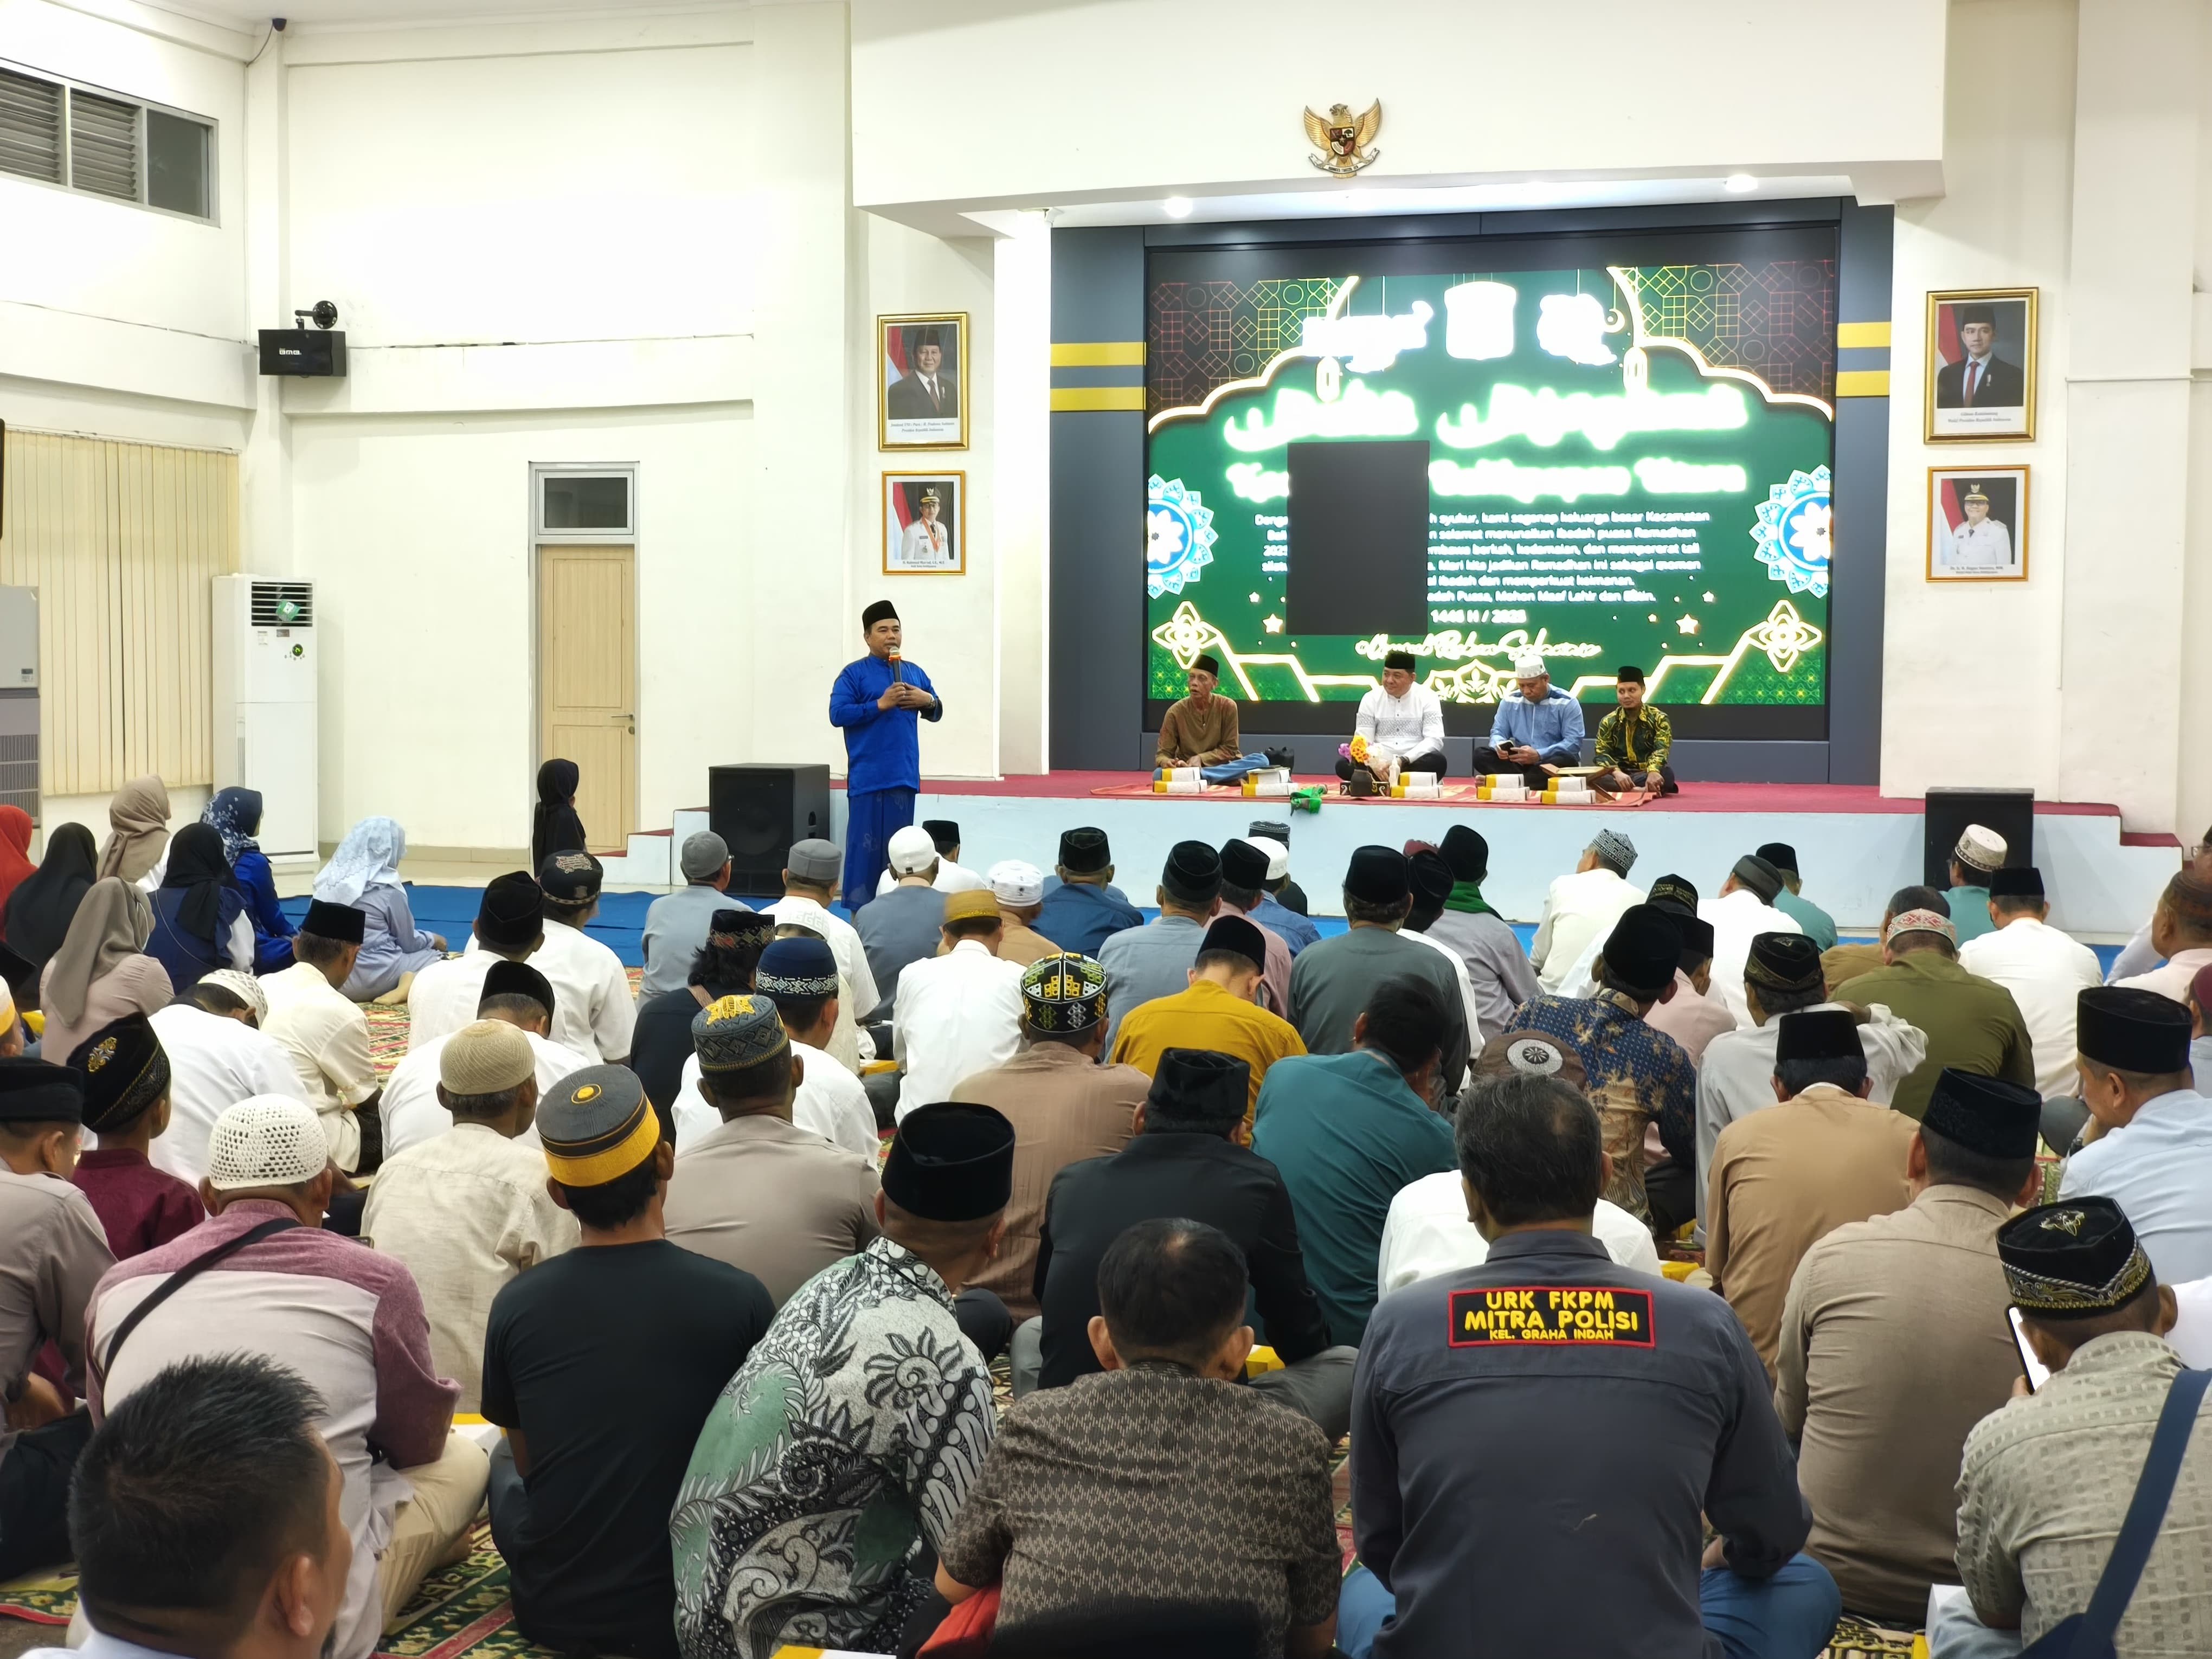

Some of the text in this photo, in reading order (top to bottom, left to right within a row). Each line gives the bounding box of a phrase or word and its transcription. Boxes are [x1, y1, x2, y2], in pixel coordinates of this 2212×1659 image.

[1646, 511, 1709, 522] Kecamatan
[1583, 543, 1605, 554] dan
[1478, 575, 1500, 586] dan
[1568, 590, 1597, 601] Lahir
[1599, 590, 1621, 601] dan
[1467, 609, 1480, 623] H
[1481, 609, 1489, 623] /
[1487, 1291, 1614, 1309] URK FKPM
[1465, 1310, 1638, 1330] MITRA POLISI
[1489, 1329, 1613, 1340] KEL. GRAHA INDAH
